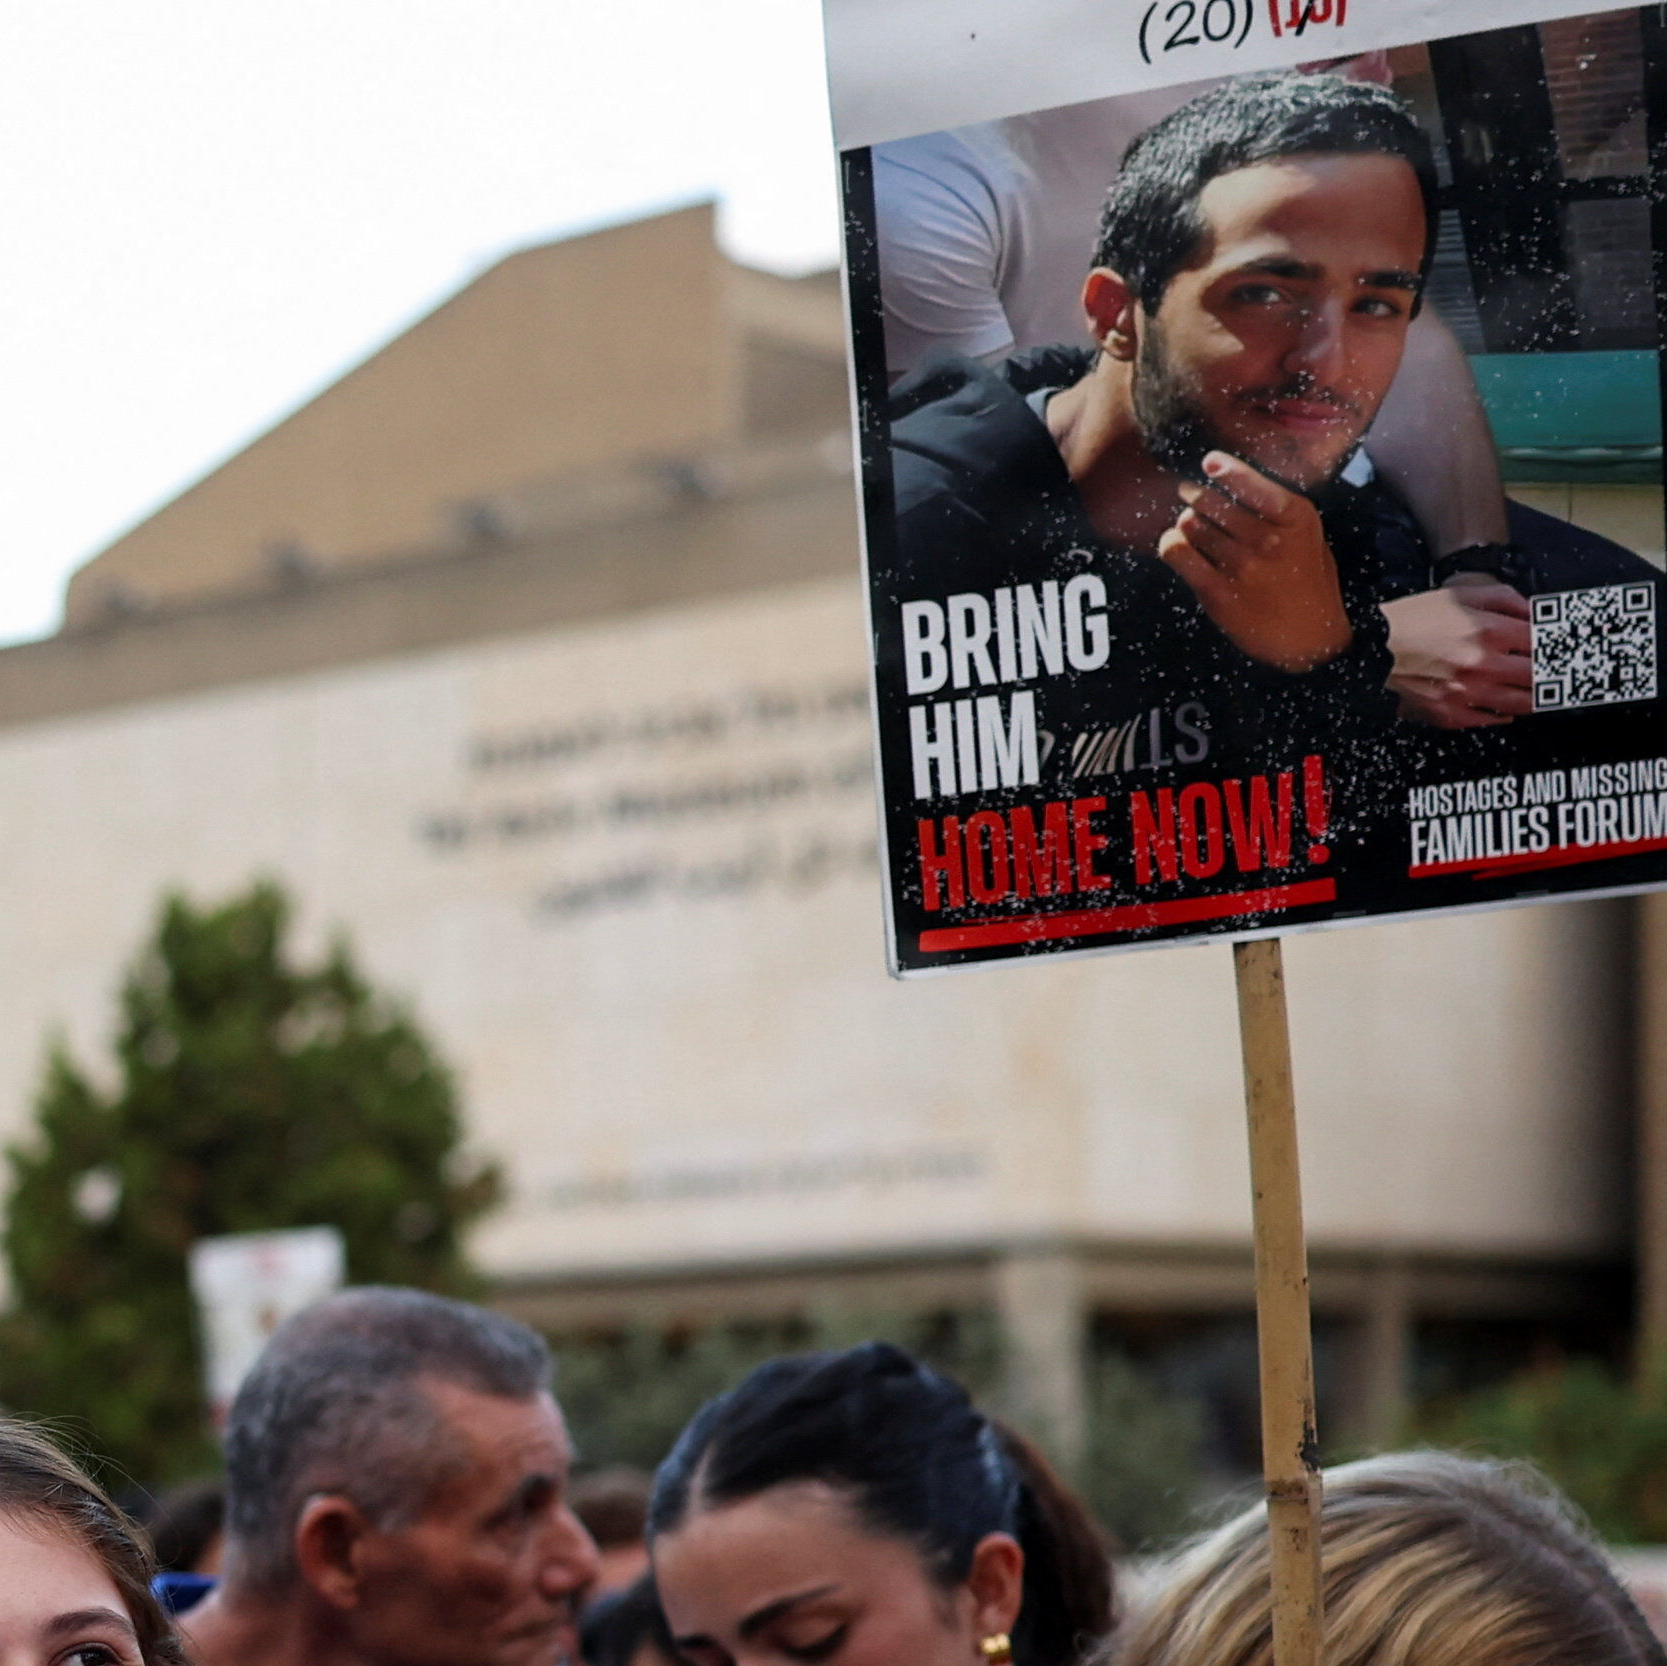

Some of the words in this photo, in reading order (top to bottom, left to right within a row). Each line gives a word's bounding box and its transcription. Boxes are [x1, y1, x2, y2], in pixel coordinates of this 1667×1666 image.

[1139, 0, 1254, 65] (20)
[901, 573, 1111, 696] BRING
[908, 690, 1041, 800] HIM
[1408, 774, 1517, 820] HOSTAGES
[1522, 769, 1567, 806] AND
[1570, 757, 1667, 800] MISSING
[917, 796, 1113, 912] HOME
[1130, 754, 1331, 886] NOW!
[1410, 805, 1551, 868] FAMILIES
[1557, 792, 1667, 850] FORUM
